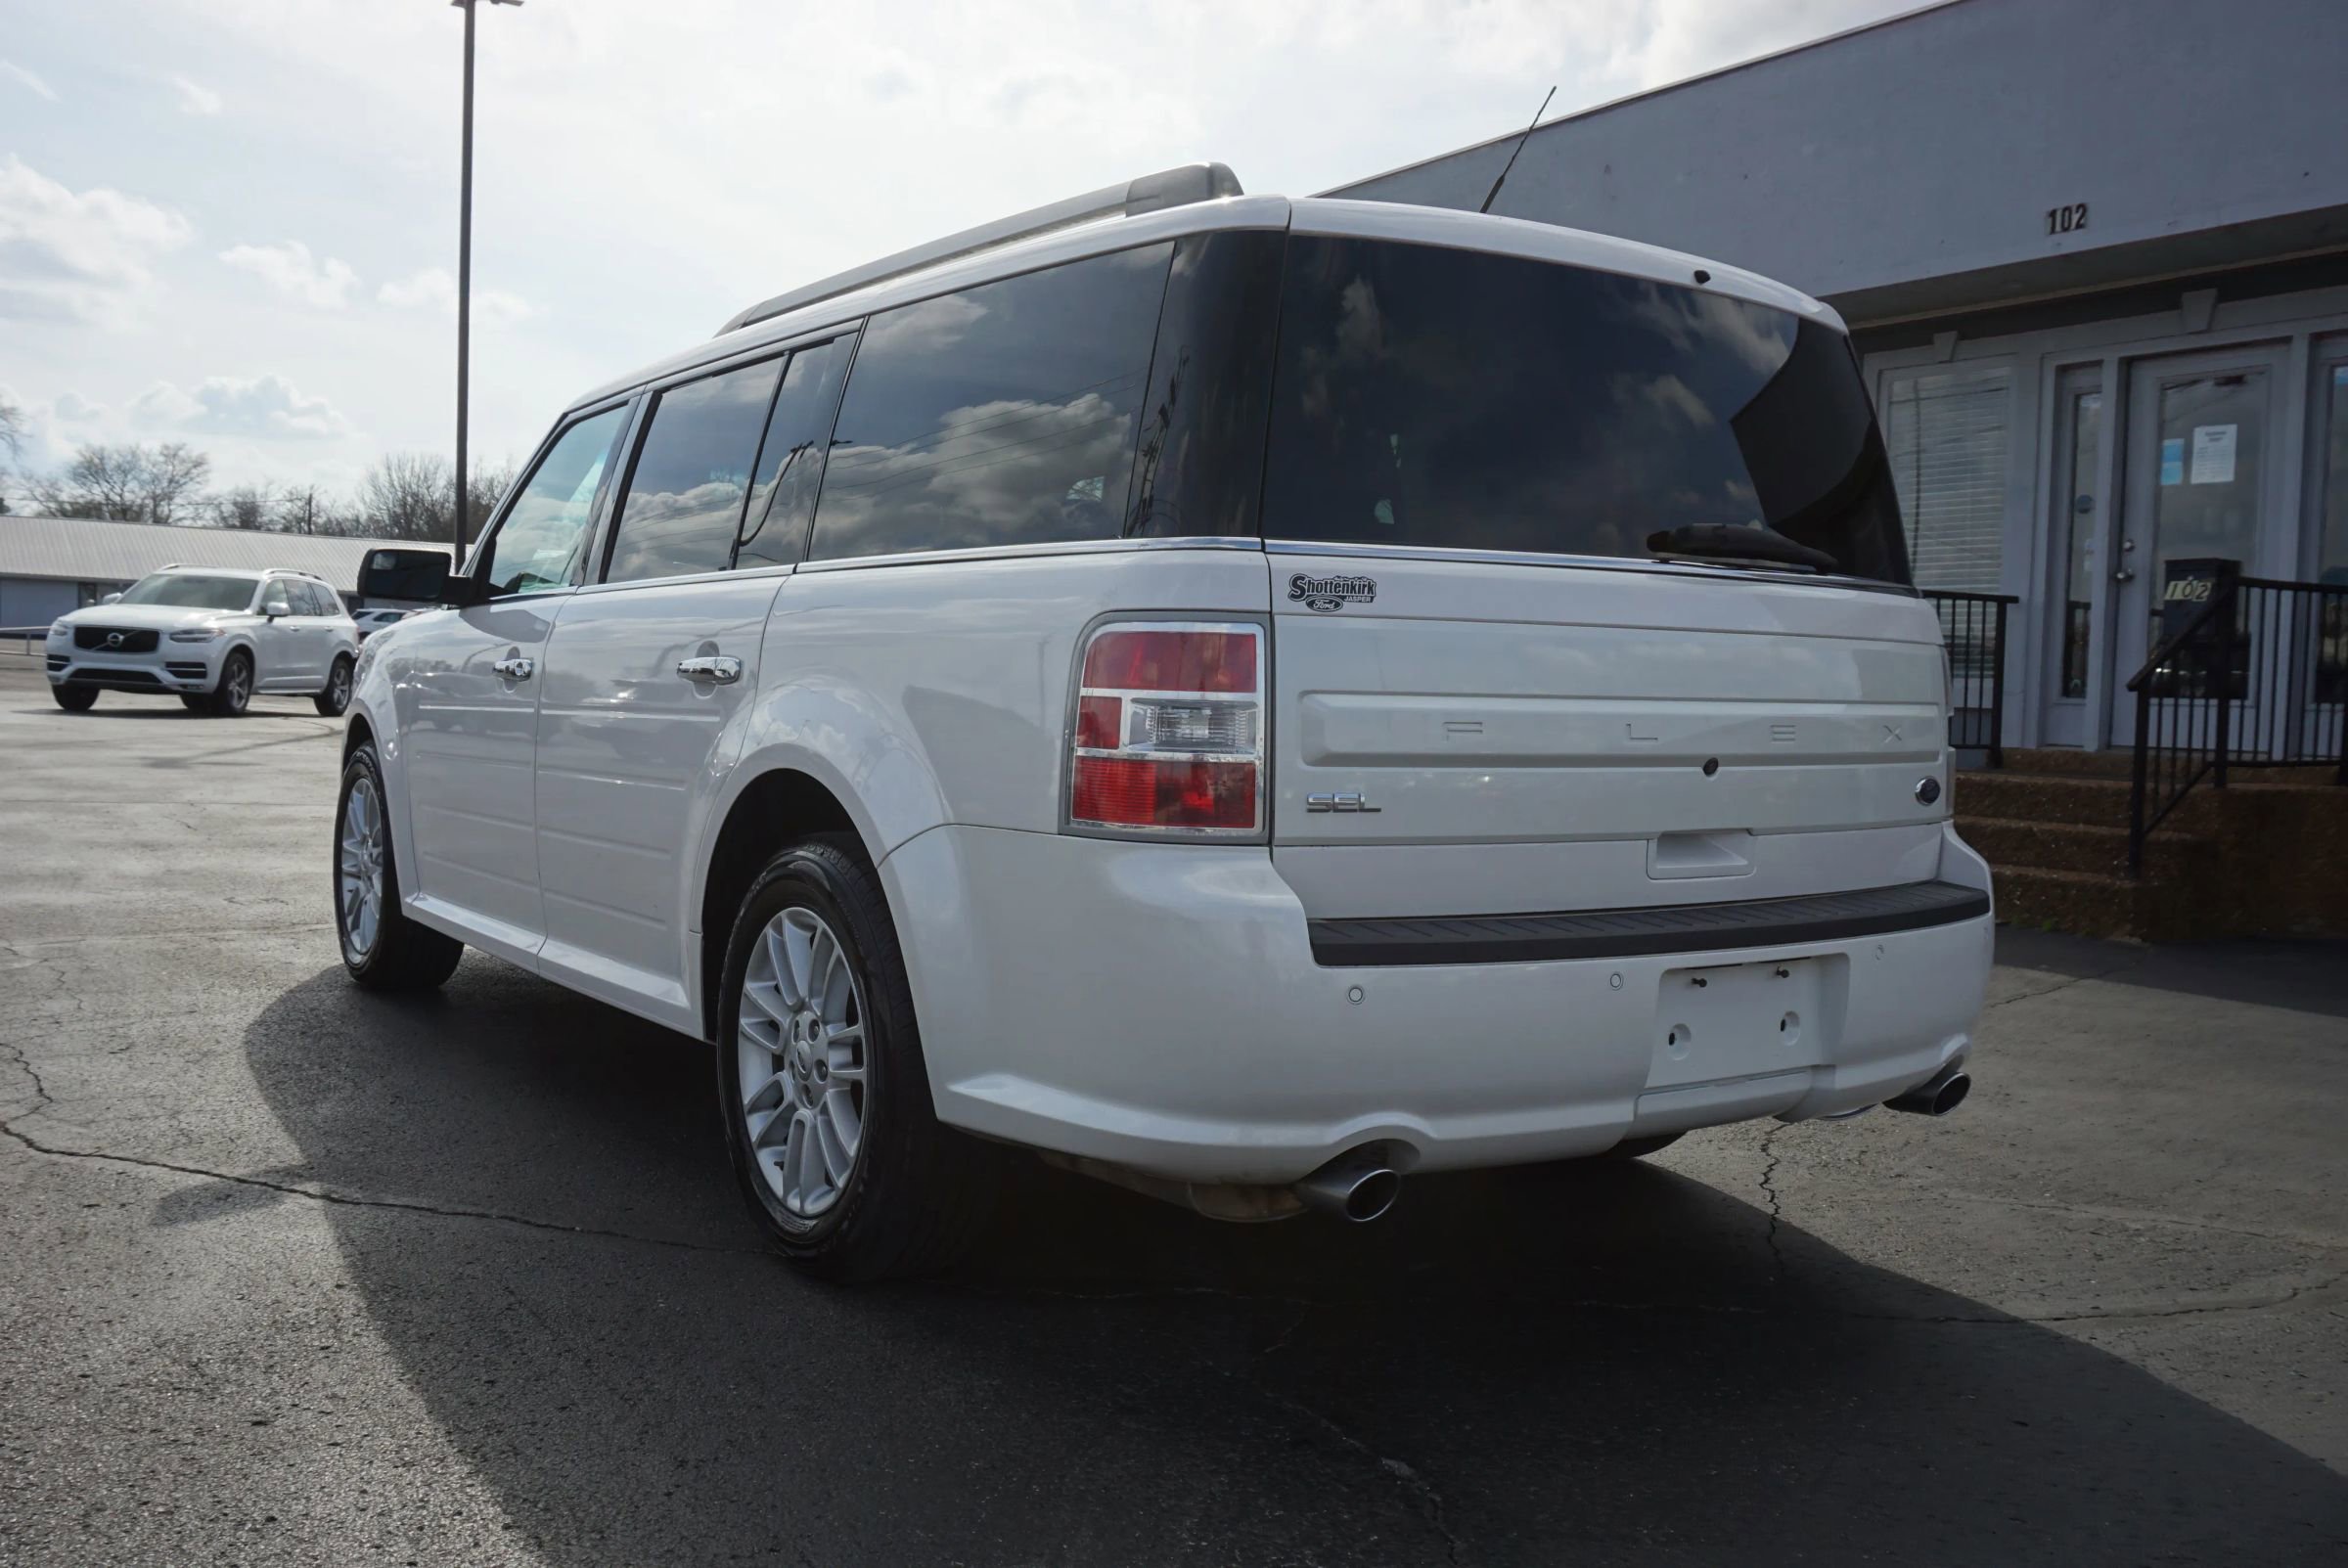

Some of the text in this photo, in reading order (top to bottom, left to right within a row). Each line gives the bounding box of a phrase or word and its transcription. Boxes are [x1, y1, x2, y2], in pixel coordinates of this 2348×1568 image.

[2048, 202, 2087, 235] 102
[1290, 575, 1375, 600] Shottenkirk
[2170, 583, 2208, 600] 102
[1313, 599, 1335, 609] Ford
[1307, 792, 1381, 813] SEL
